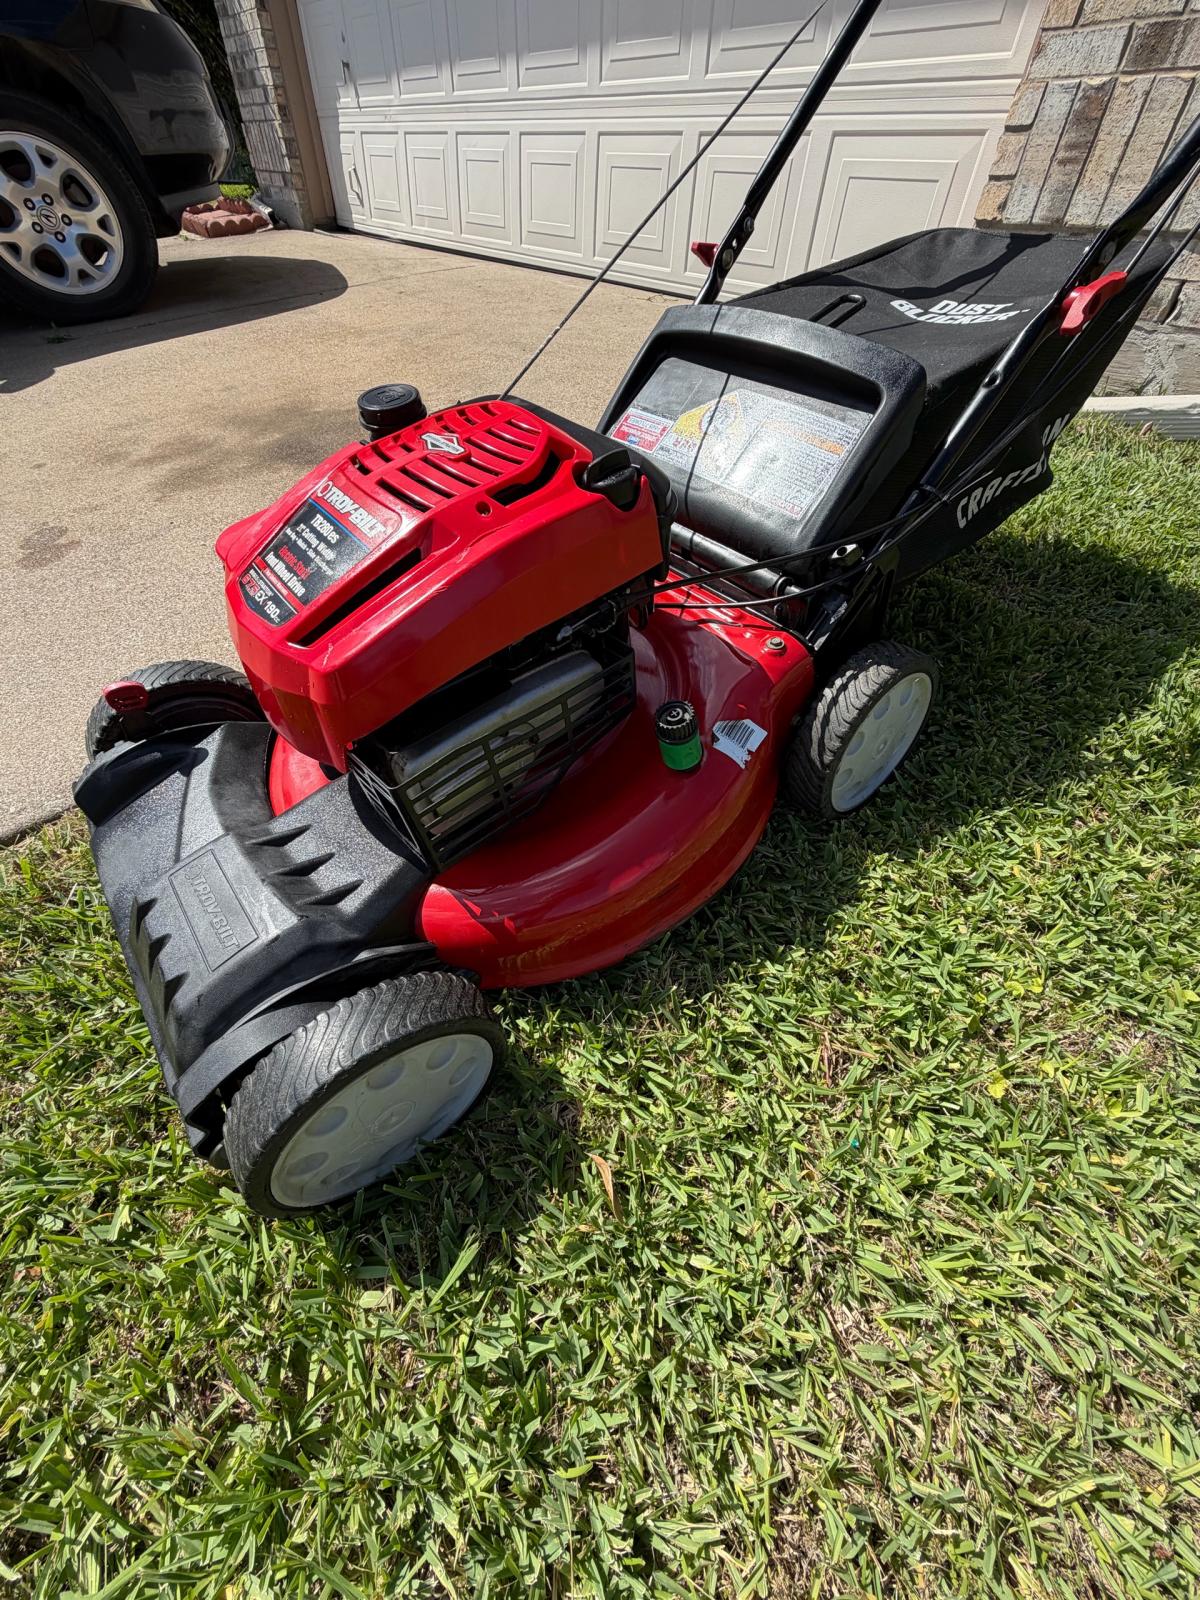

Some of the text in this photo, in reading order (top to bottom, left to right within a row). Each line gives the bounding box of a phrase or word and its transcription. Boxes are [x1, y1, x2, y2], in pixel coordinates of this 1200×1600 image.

[889, 299, 1021, 325] BLOCKER
[928, 299, 1014, 315] DUST
[323, 485, 386, 538] TROY-BILT
[302, 529, 320, 548] Cutting
[279, 545, 299, 570] Electric
[264, 551, 280, 569] Front
[273, 560, 294, 583] Wheel
[287, 575, 306, 597] Drive
[190, 874, 241, 950] TROY-BILT
